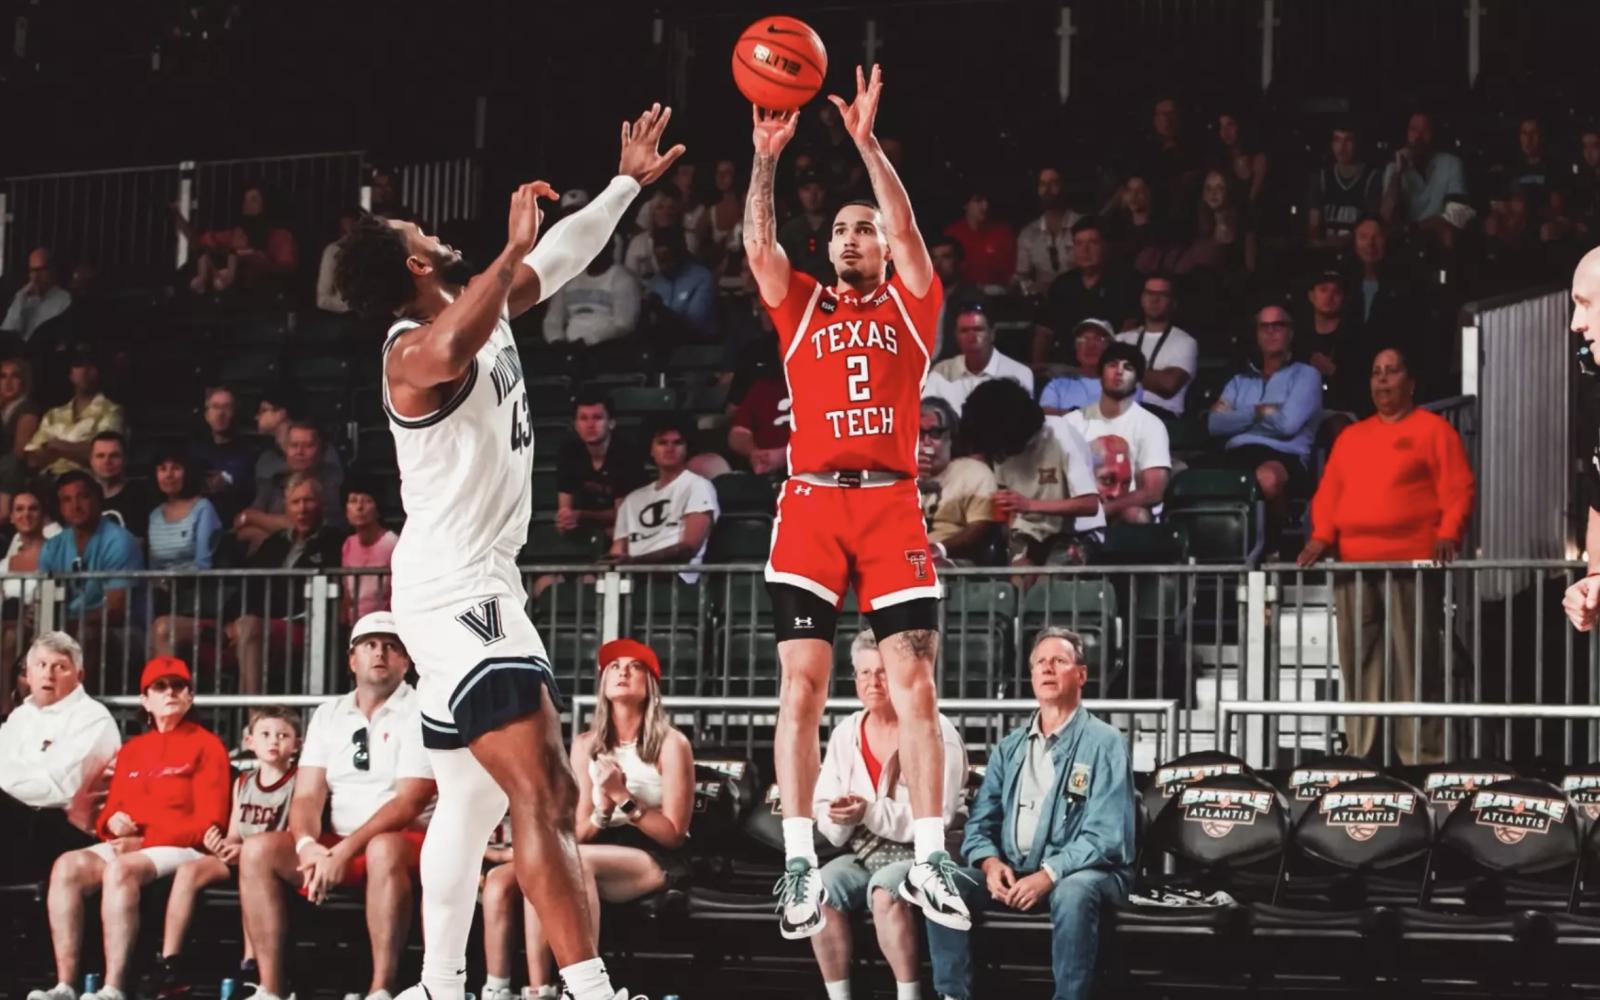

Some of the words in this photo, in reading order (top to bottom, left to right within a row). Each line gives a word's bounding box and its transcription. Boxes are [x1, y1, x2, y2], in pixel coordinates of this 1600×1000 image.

[811, 319, 899, 360] TEXAS
[846, 355, 872, 402] 2
[825, 406, 895, 439] TECH
[455, 596, 506, 647] V
[1181, 789, 1271, 811] BATTLE
[1323, 793, 1415, 811] BATTLE
[1475, 792, 1566, 819] BATTLE
[240, 804, 278, 825] TEC
[1189, 807, 1251, 820] ATLANTIS
[1333, 811, 1395, 821] ATLANTIS
[1482, 812, 1545, 828] ATLANTIS
